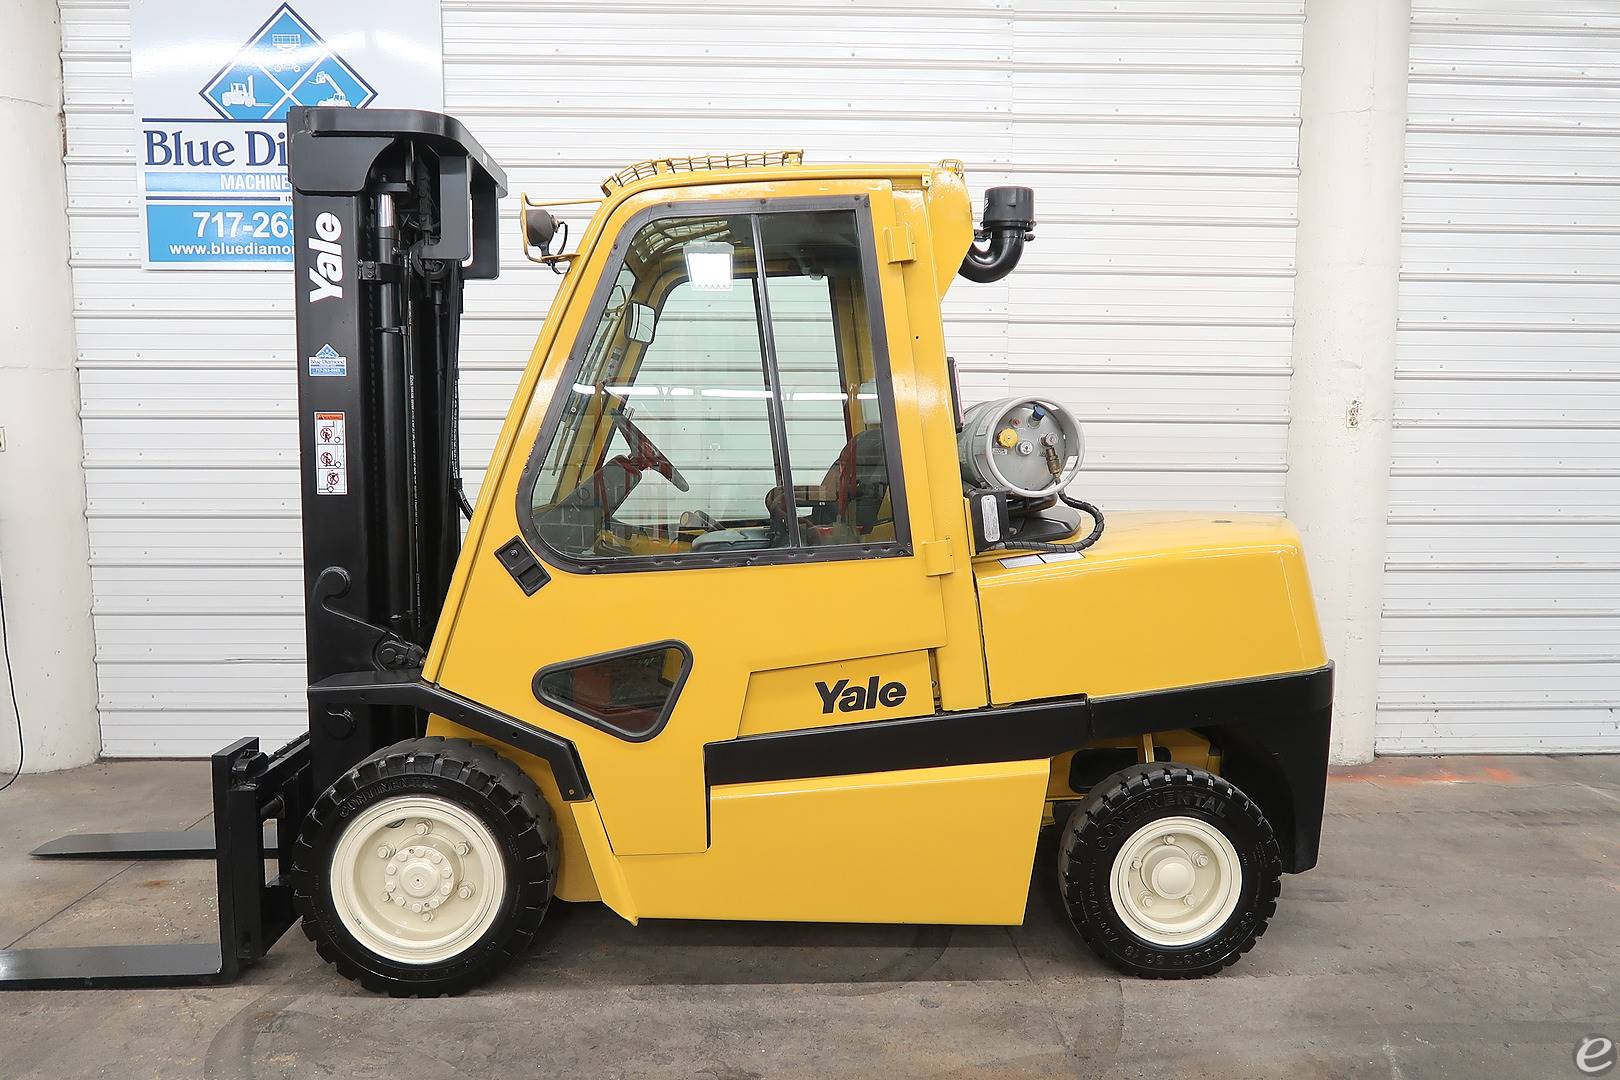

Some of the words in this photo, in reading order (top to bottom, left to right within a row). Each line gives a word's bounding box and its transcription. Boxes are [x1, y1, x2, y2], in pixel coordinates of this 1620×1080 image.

[144, 130, 235, 167] Blue
[220, 174, 290, 191] MACHINE
[308, 211, 343, 302] Yale
[815, 675, 907, 714] Yale
[1096, 789, 1228, 853] CONTINENTAL
